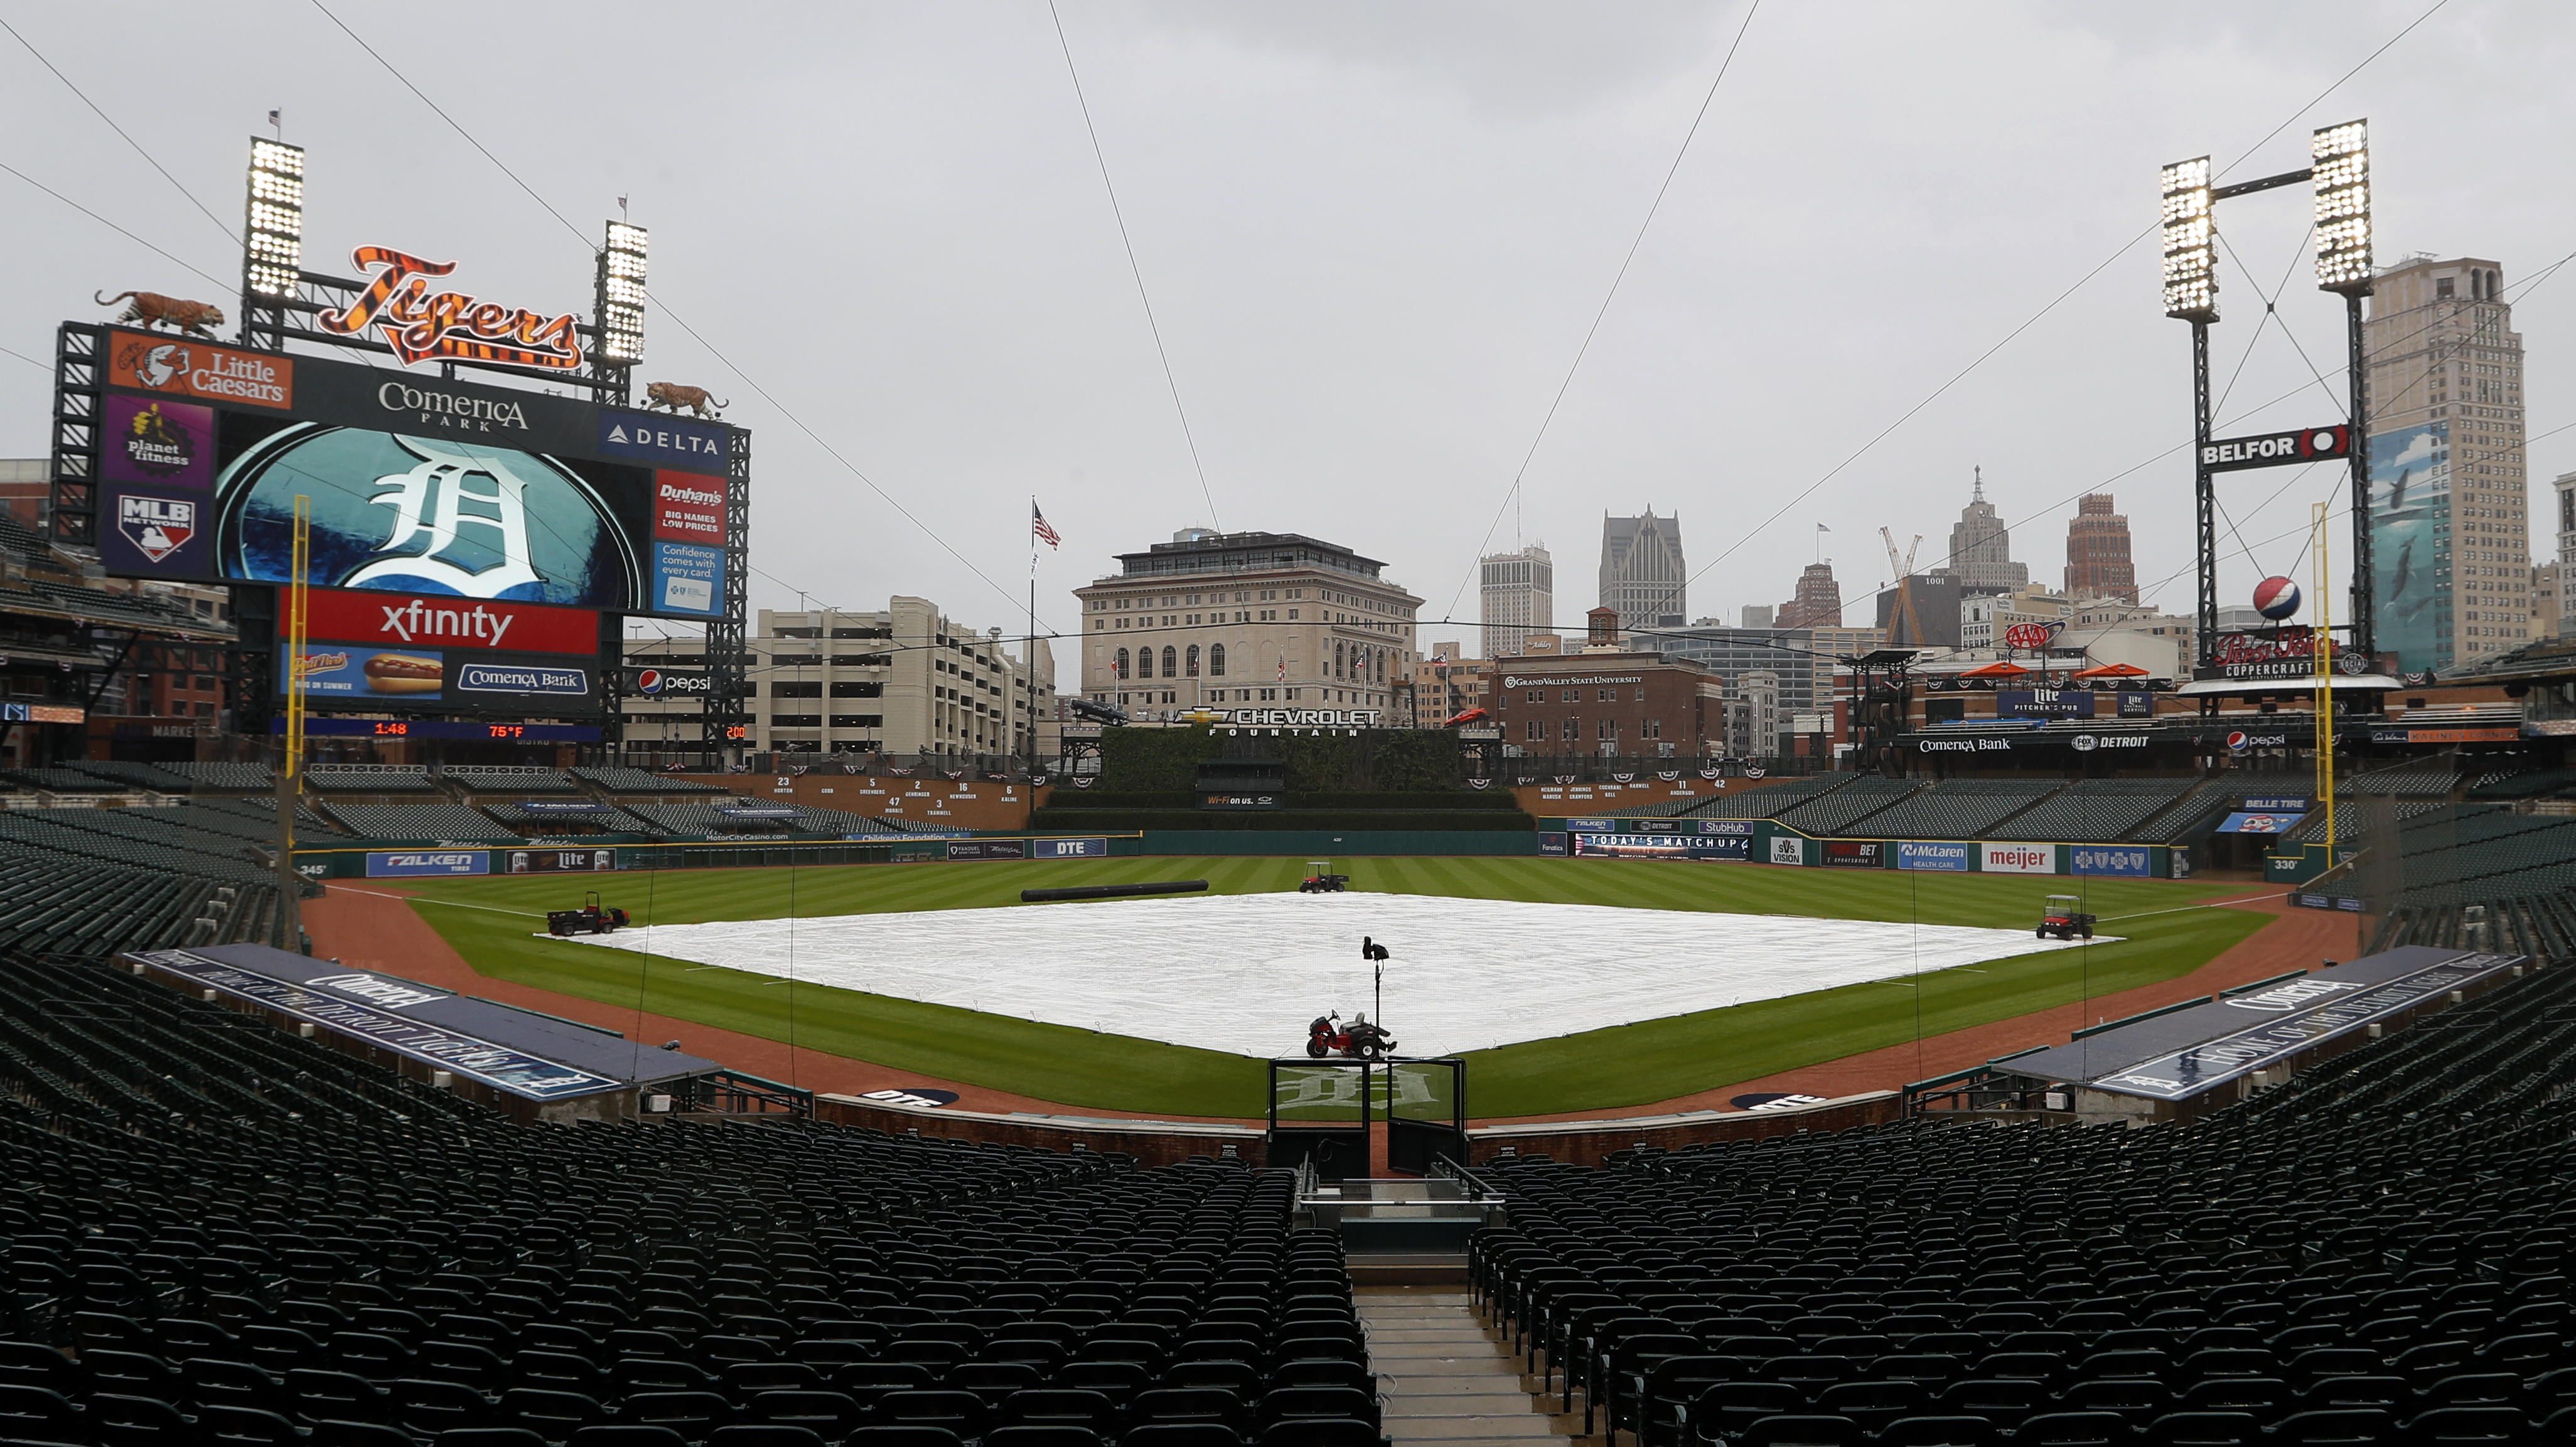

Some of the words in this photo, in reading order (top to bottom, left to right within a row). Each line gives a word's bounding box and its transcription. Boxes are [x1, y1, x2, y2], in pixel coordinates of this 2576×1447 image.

[316, 243, 583, 370] Tigers
[212, 353, 275, 383] Little
[191, 369, 283, 402] Caesars
[421, 413, 490, 432] PARK
[127, 440, 179, 456] planet
[637, 429, 718, 455] DELTA
[2203, 437, 2294, 464] BELFOR
[135, 450, 188, 466] fitness
[660, 484, 722, 504] Dunham's
[124, 499, 190, 520] MLB
[123, 518, 190, 528] NETWORK
[665, 511, 681, 519] BIG
[684, 513, 716, 523] NAMES
[662, 520, 683, 528] LOW
[685, 522, 718, 532] PRICES
[663, 545, 715, 558] Confidence
[663, 557, 693, 566] comes
[695, 560, 715, 568] with
[662, 567, 688, 577] every
[380, 600, 513, 646] xfinity
[2007, 624, 2046, 648] AAA
[2226, 663, 2312, 676] COPPERCRAFT
[542, 673, 577, 687] Bank
[666, 676, 711, 692] pepsi
[1516, 678, 1543, 686] GRAND
[1543, 677, 1570, 685] VALLEY
[1571, 676, 1595, 685] STATE
[1594, 676, 1642, 684] UNIVERSITY
[2034, 688, 2059, 704] Lite
[2128, 695, 2142, 704] Lite
[1235, 709, 1380, 725] CHEVROLET
[375, 722, 407, 735] 1:48
[1978, 738, 2010, 750] Bank
[2100, 737, 2149, 748] DETROIT
[2249, 734, 2285, 746] pepsi
[778, 777, 790, 786] 23
[870, 779, 876, 787] 5
[915, 781, 920, 789] 2
[959, 782, 968, 791] 16
[1678, 780, 1687, 789] 11
[1714, 779, 1725, 788] 42
[1007, 786, 1012, 794] 6
[889, 797, 900, 806] 47
[936, 799, 942, 808] 3
[1208, 796, 1230, 804] Wi-Fi
[2245, 800, 2278, 808] BELLE
[1706, 822, 1745, 833] StubHub
[1057, 841, 1085, 855] DTE
[1592, 836, 1653, 846] TODAY'S
[1664, 838, 1737, 848] MATCHUP
[1918, 845, 1964, 858] McLaren
[387, 855, 472, 867] FALKEN
[558, 852, 585, 869] Lite
[1774, 854, 1800, 863] VISION
[1990, 847, 2046, 869] meijer
[300, 865, 326, 875] 345'
[2275, 860, 2298, 870] 330'
[197, 970, 264, 986] HOME
[267, 992, 324, 1005] THE
[302, 1004, 416, 1035] DETROIT
[396, 1032, 510, 1066] TIGERS
[2188, 1037, 2289, 1065] HOME
[2267, 1020, 2317, 1039] OF
[2294, 1011, 2356, 1029] THE
[2327, 983, 2420, 1015] DETROIT
[2407, 972, 2463, 990] TIGERS
[862, 1090, 943, 1107] DTE
